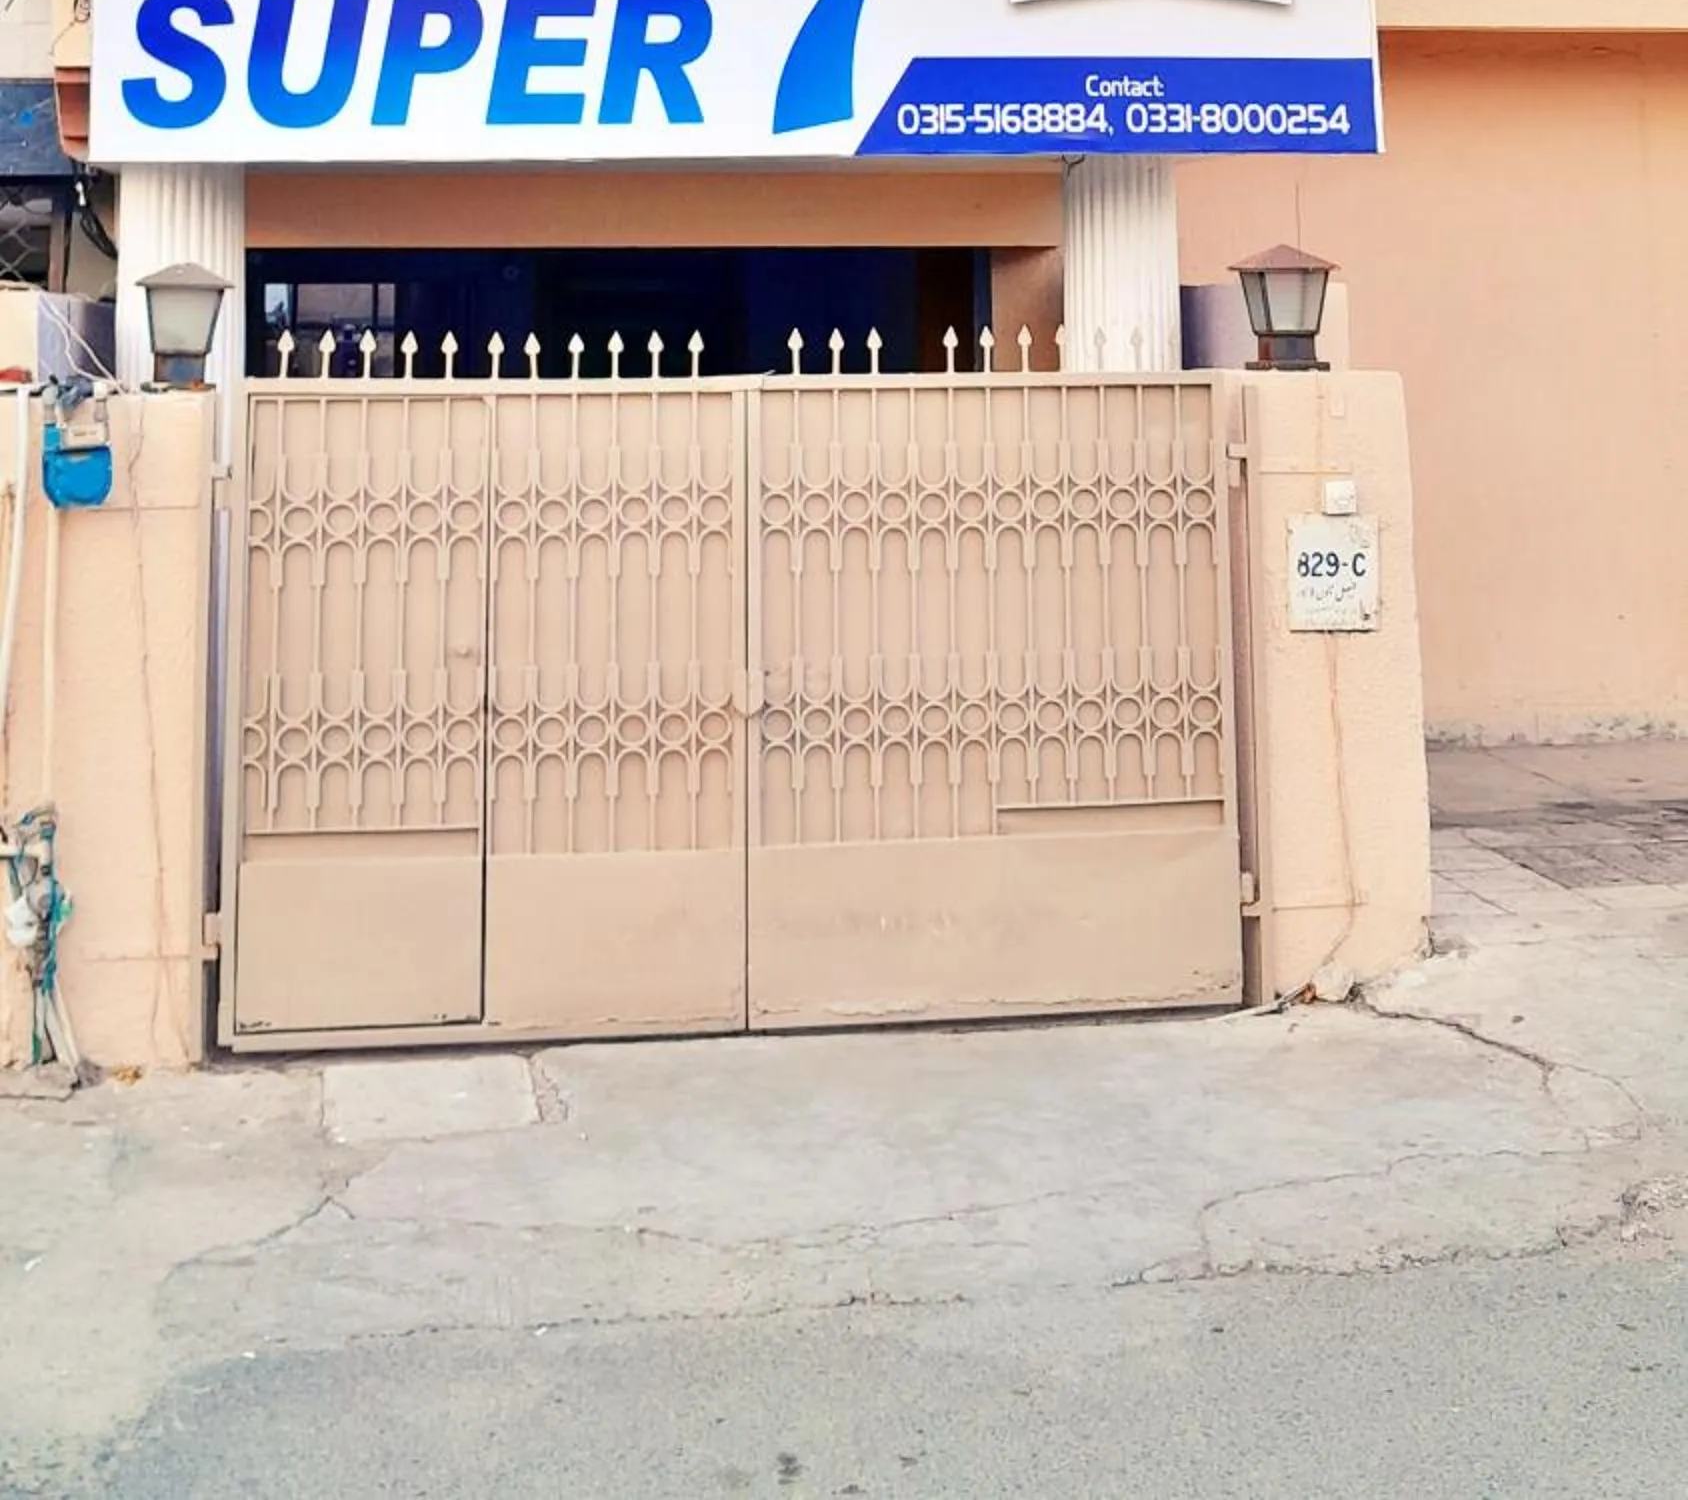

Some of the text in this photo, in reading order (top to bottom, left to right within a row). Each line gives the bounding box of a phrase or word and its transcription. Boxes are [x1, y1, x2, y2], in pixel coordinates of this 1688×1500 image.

[896, 102, 1351, 137] 0315-5168884, 0331-8000254
[1297, 551, 1367, 577] 829-C
